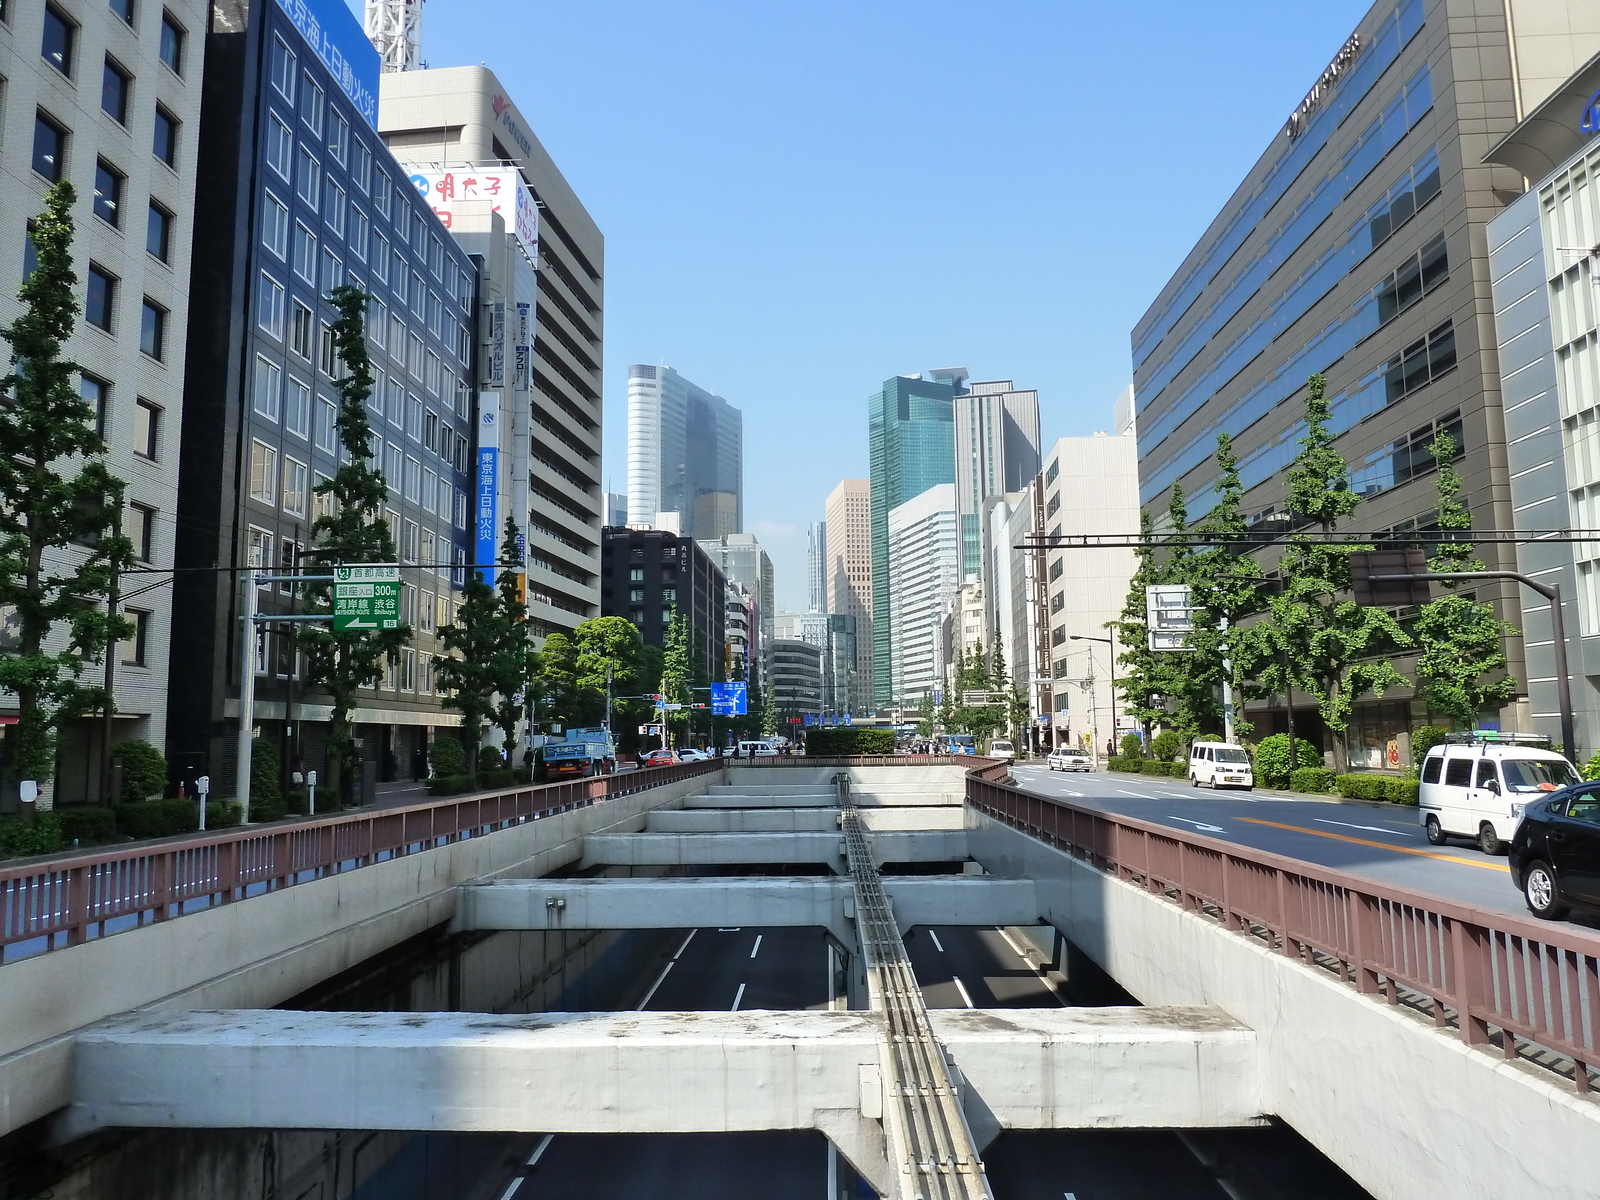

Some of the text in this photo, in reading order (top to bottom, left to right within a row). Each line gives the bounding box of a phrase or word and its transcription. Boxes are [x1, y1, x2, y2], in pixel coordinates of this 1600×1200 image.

[435, 173, 502, 202] 明太子
[480, 452, 493, 540] 東京海上日動火災
[354, 567, 395, 577] 首都高速
[338, 585, 397, 596] 銀座入口 300m
[336, 598, 396, 610] 湾岸線 渋谷
